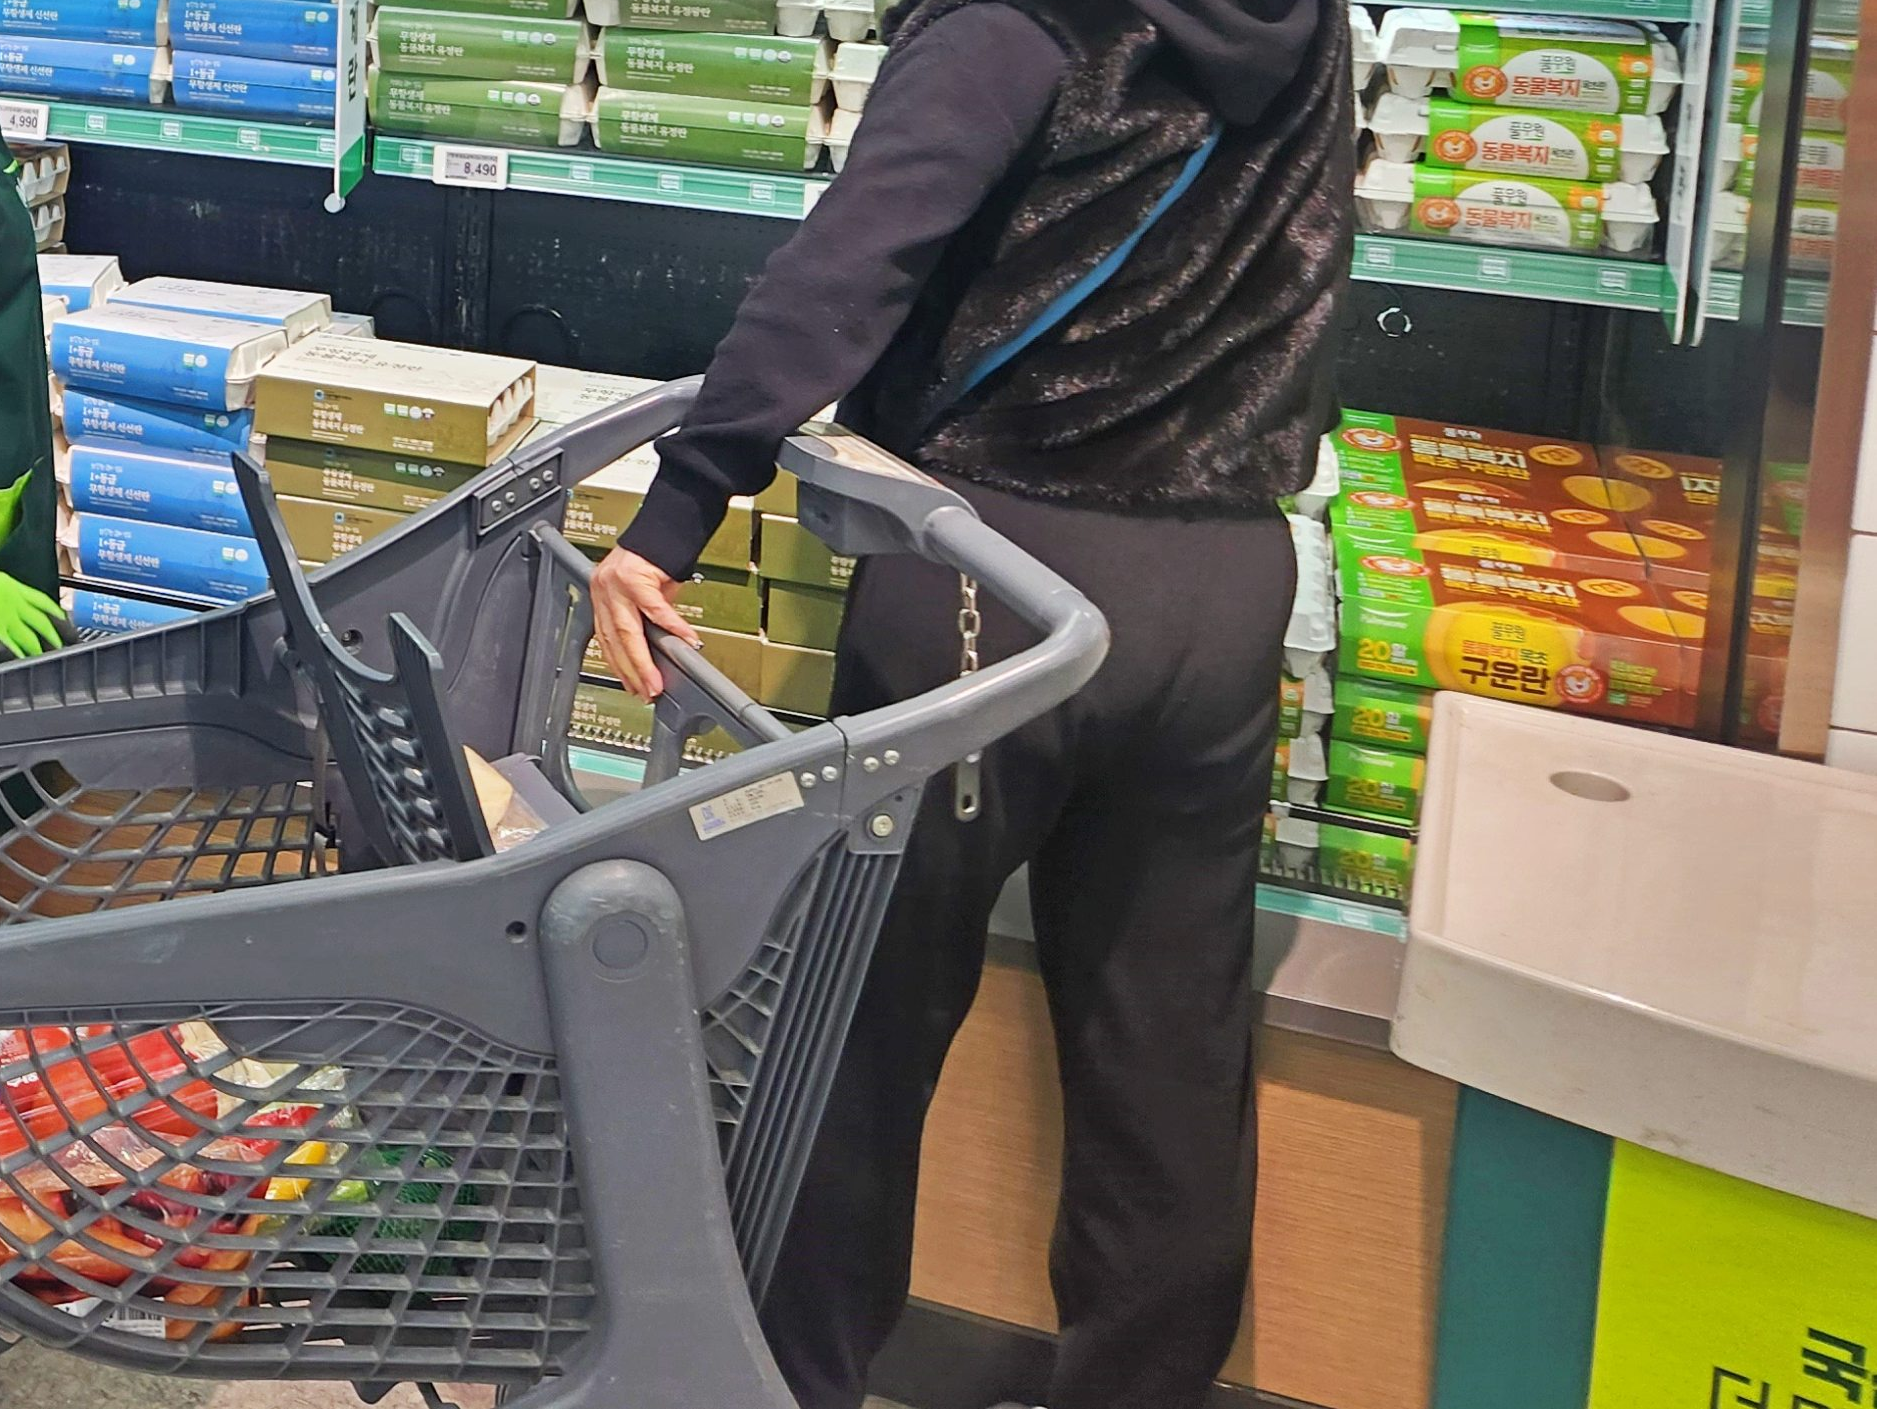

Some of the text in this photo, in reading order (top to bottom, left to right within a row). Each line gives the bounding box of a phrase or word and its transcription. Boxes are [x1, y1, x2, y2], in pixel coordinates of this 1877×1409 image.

[348, 1, 359, 101] 계란
[1512, 75, 1581, 99] 동물복지
[10, 115, 38, 129] 4,990
[464, 162, 498, 178] 8,490
[1410, 438, 1527, 469] 동물복지
[1460, 655, 1551, 695] 구운란
